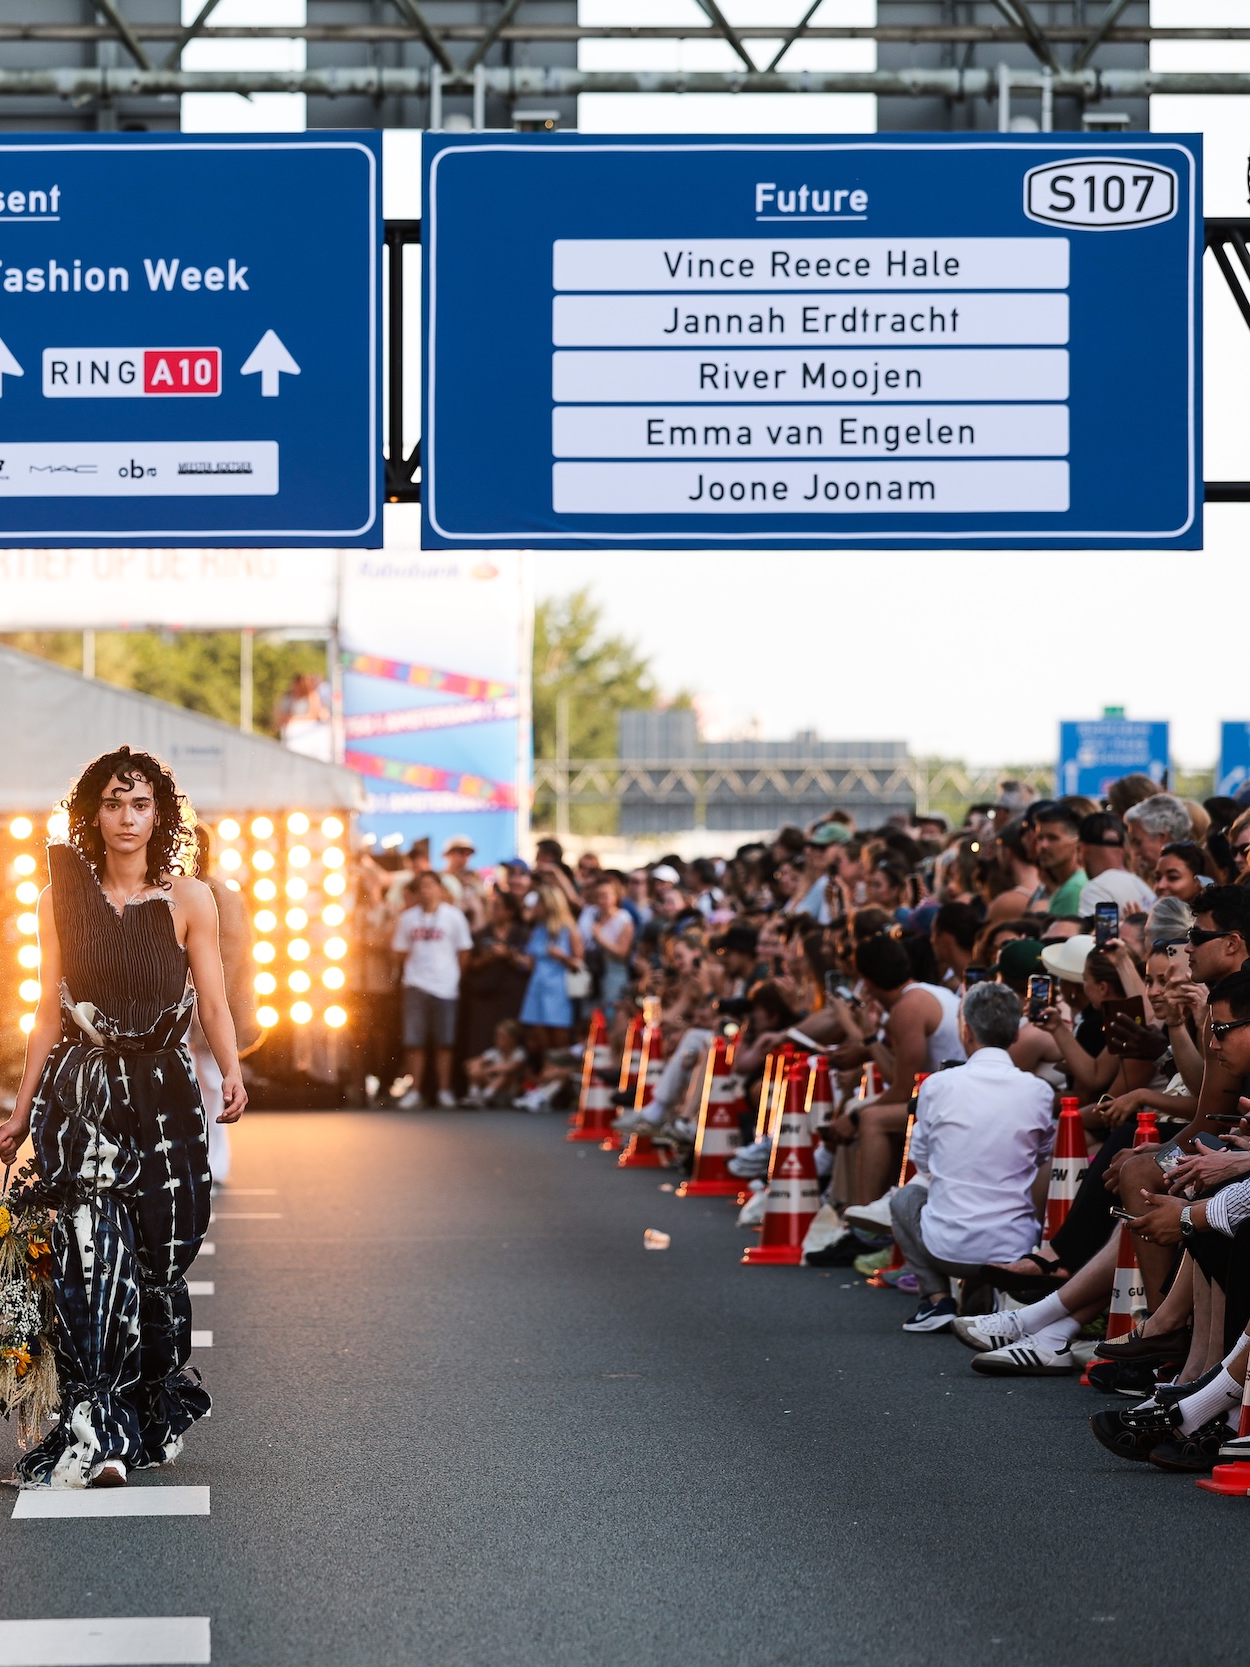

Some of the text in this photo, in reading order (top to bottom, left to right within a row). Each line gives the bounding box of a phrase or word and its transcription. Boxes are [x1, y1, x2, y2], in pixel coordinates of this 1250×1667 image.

[755, 182, 869, 213] Future
[1048, 175, 1156, 214] S107
[143, 258, 250, 292] Week
[663, 250, 960, 278] Vince Reece Hale
[663, 306, 959, 334] Jannah Erdtracht
[51, 358, 212, 386] RING A10
[700, 362, 921, 396] River Moojen
[647, 418, 974, 453] Emma van Engelen
[688, 474, 935, 501] Joone Joonam
